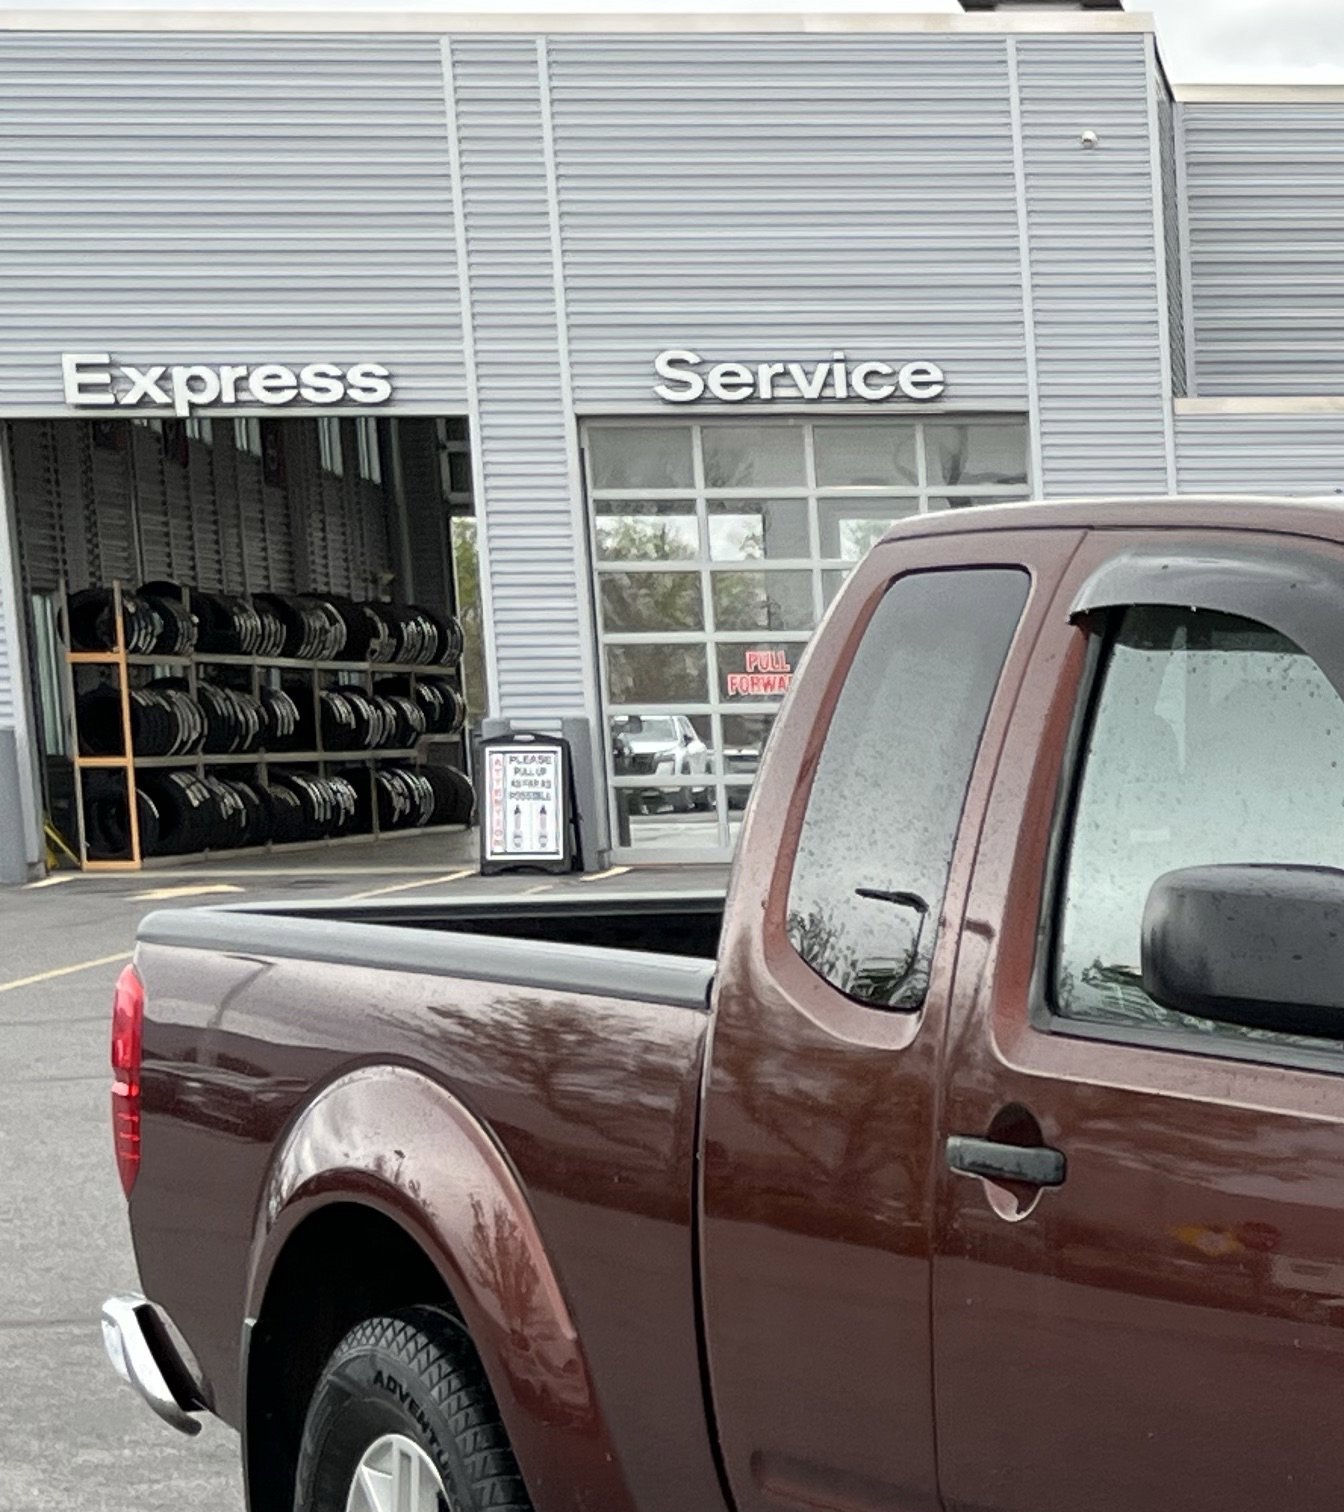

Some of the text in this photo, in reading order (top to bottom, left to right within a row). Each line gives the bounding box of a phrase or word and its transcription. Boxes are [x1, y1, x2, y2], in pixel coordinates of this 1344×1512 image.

[61, 352, 394, 417] Express
[652, 349, 946, 403] Service
[745, 650, 791, 673] PULL
[509, 756, 552, 765] PLEASE
[514, 766, 547, 776] PULL UP
[493, 758, 503, 847] ATTENTION
